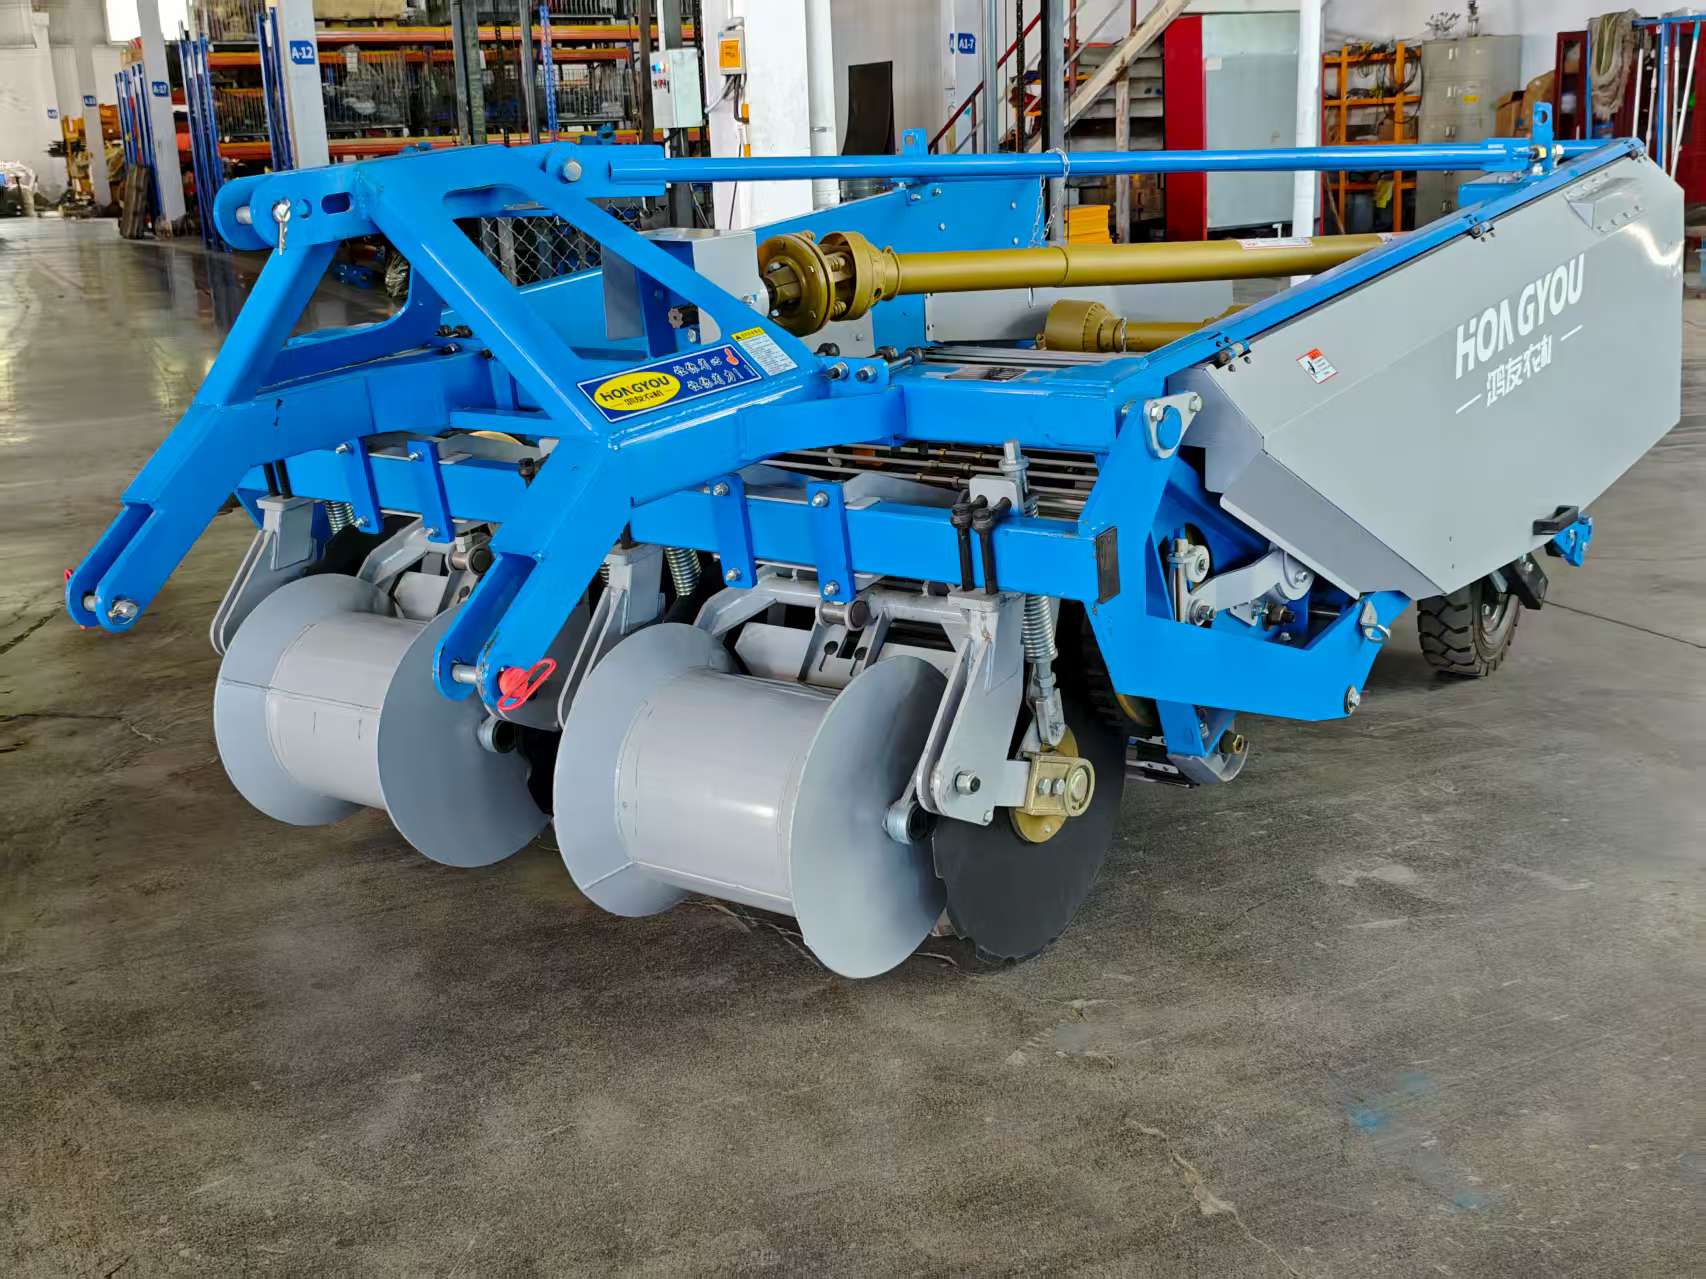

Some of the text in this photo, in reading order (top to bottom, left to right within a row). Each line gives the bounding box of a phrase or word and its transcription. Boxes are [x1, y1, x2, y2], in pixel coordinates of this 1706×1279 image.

[292, 46, 314, 60] A-12
[959, 38, 975, 49] A1-7
[1455, 253, 1585, 380] HONGYOU
[599, 375, 671, 402] HONGYOU
